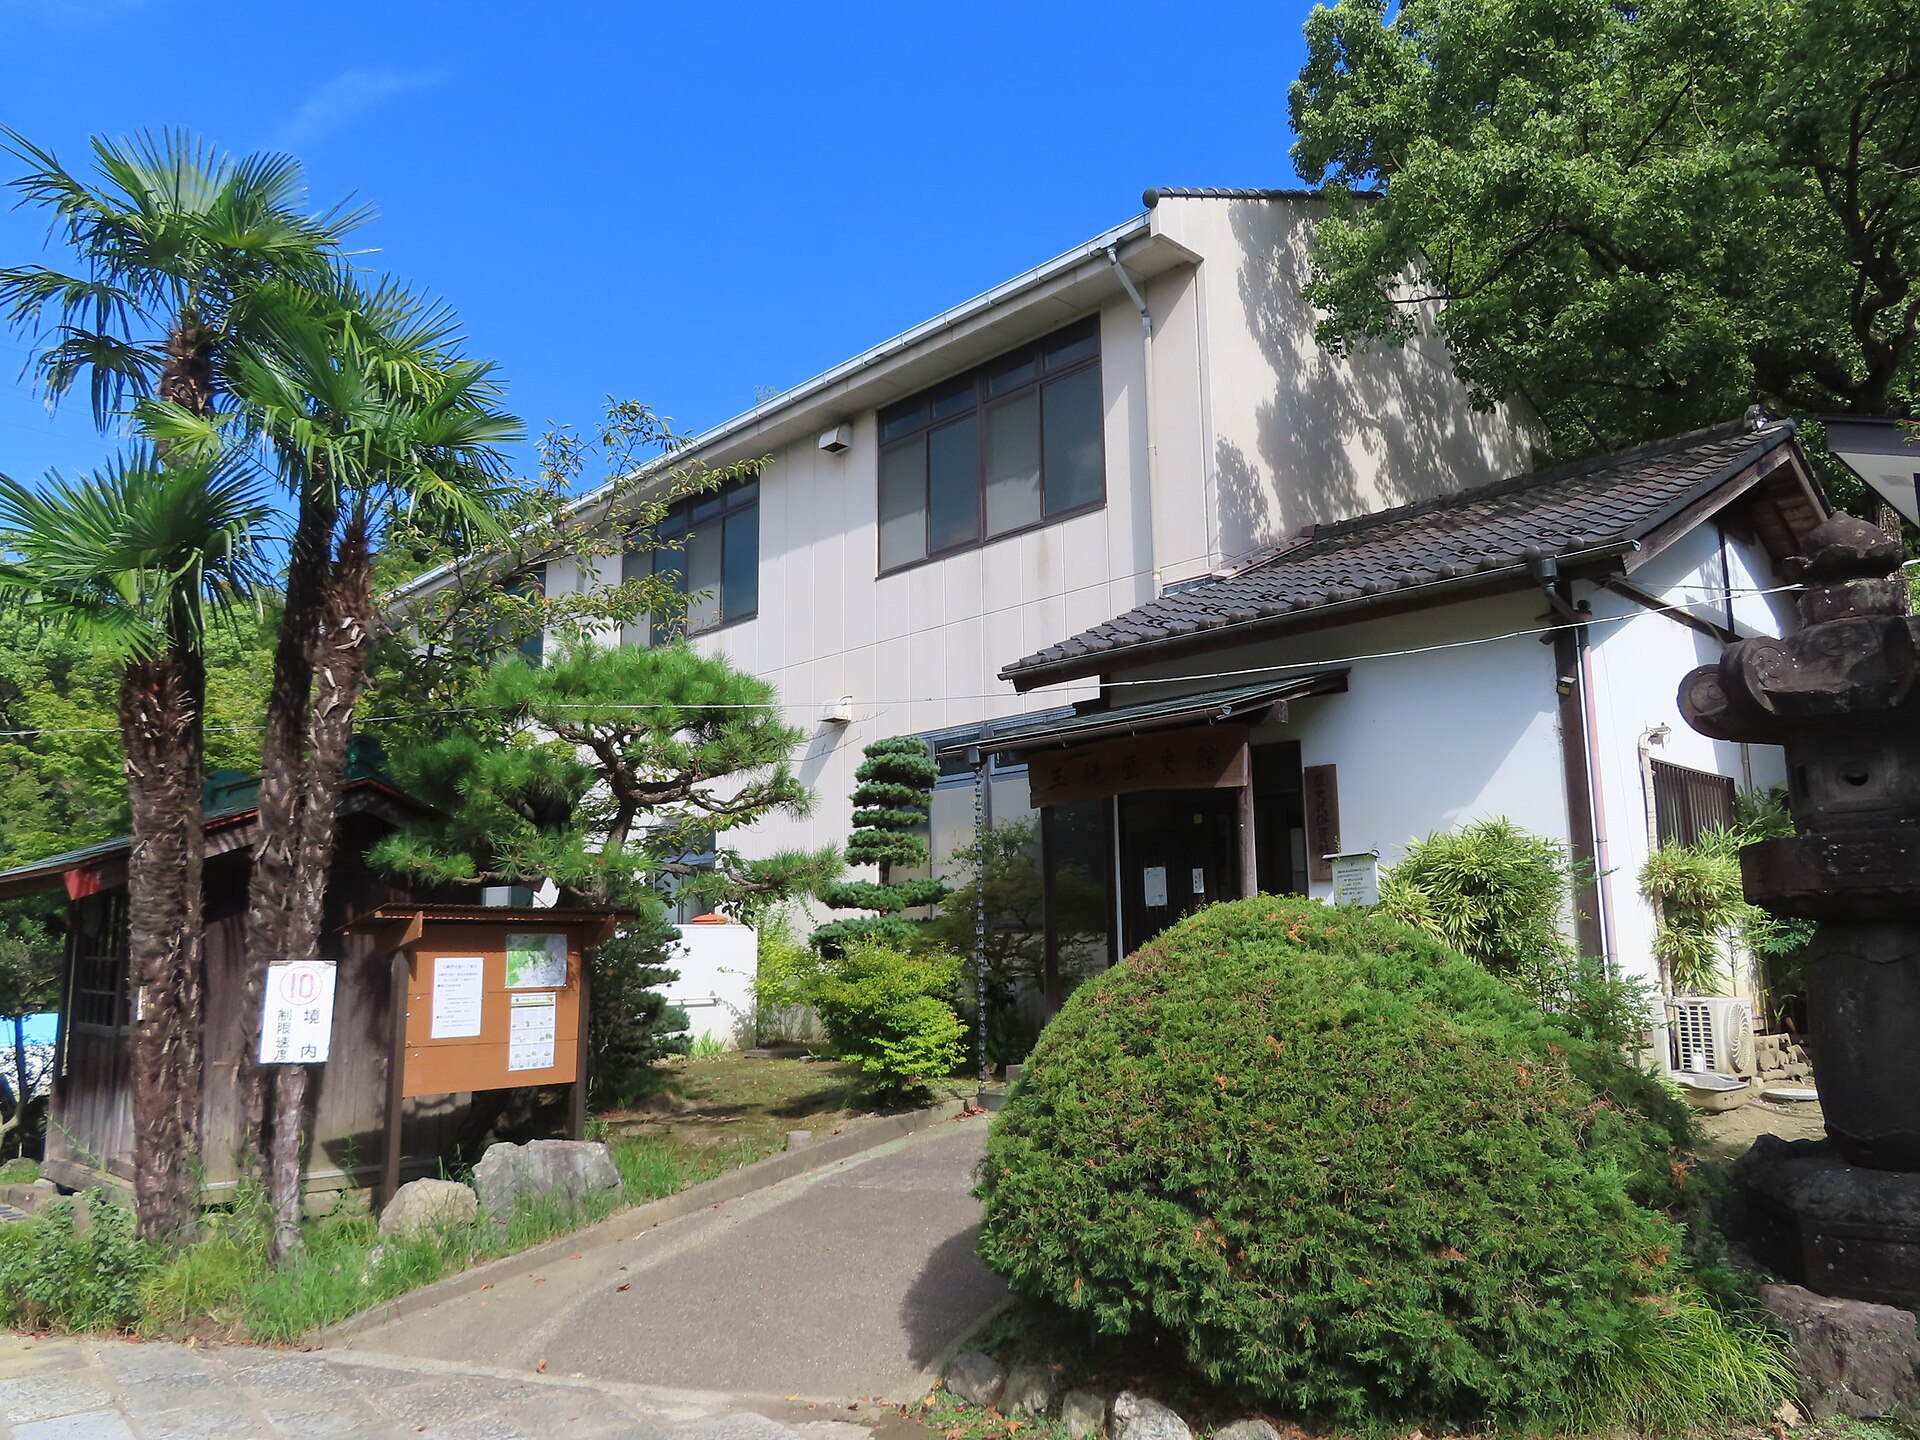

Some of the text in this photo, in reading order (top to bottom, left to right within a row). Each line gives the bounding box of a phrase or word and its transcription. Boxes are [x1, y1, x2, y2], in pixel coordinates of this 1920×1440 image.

[291, 974, 315, 999] 10
[273, 1009, 292, 1061] 制限速度
[301, 1009, 320, 1058] 境内
